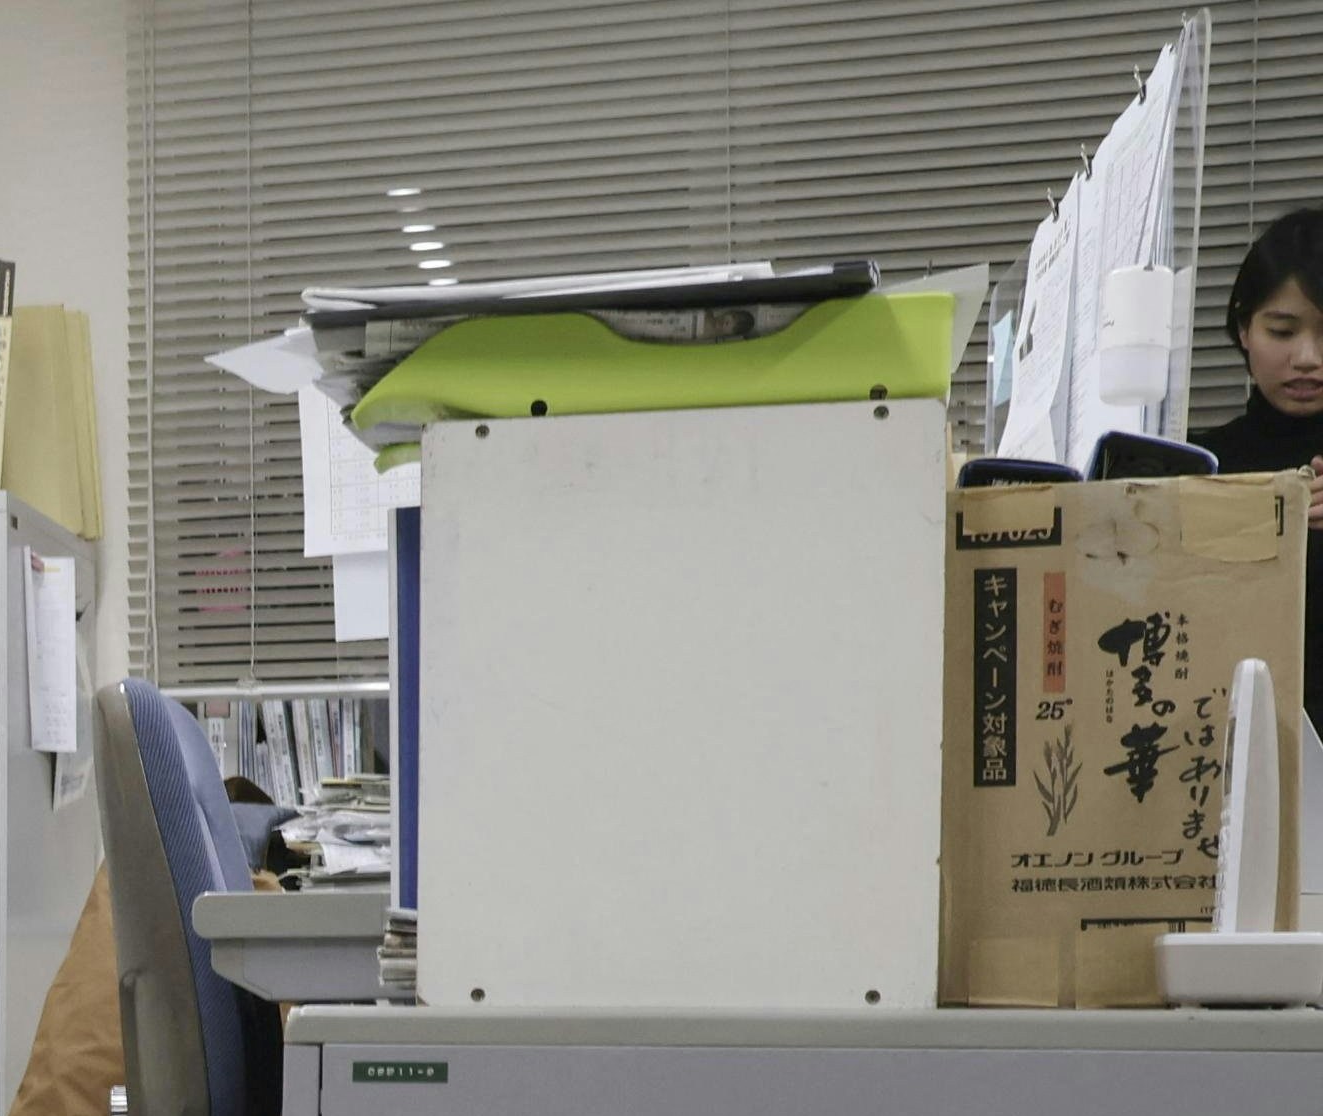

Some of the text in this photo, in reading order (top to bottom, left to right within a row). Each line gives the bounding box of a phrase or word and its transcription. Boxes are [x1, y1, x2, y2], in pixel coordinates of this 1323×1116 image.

[1047, 600, 1063, 677] むぎ焼酎
[1175, 613, 1189, 680] 本格焼酎
[983, 575, 1008, 781] キャンペーン対象品
[1098, 611, 1181, 803] 博多の華
[1011, 874, 1216, 893] 福徳長酒類株式会社
